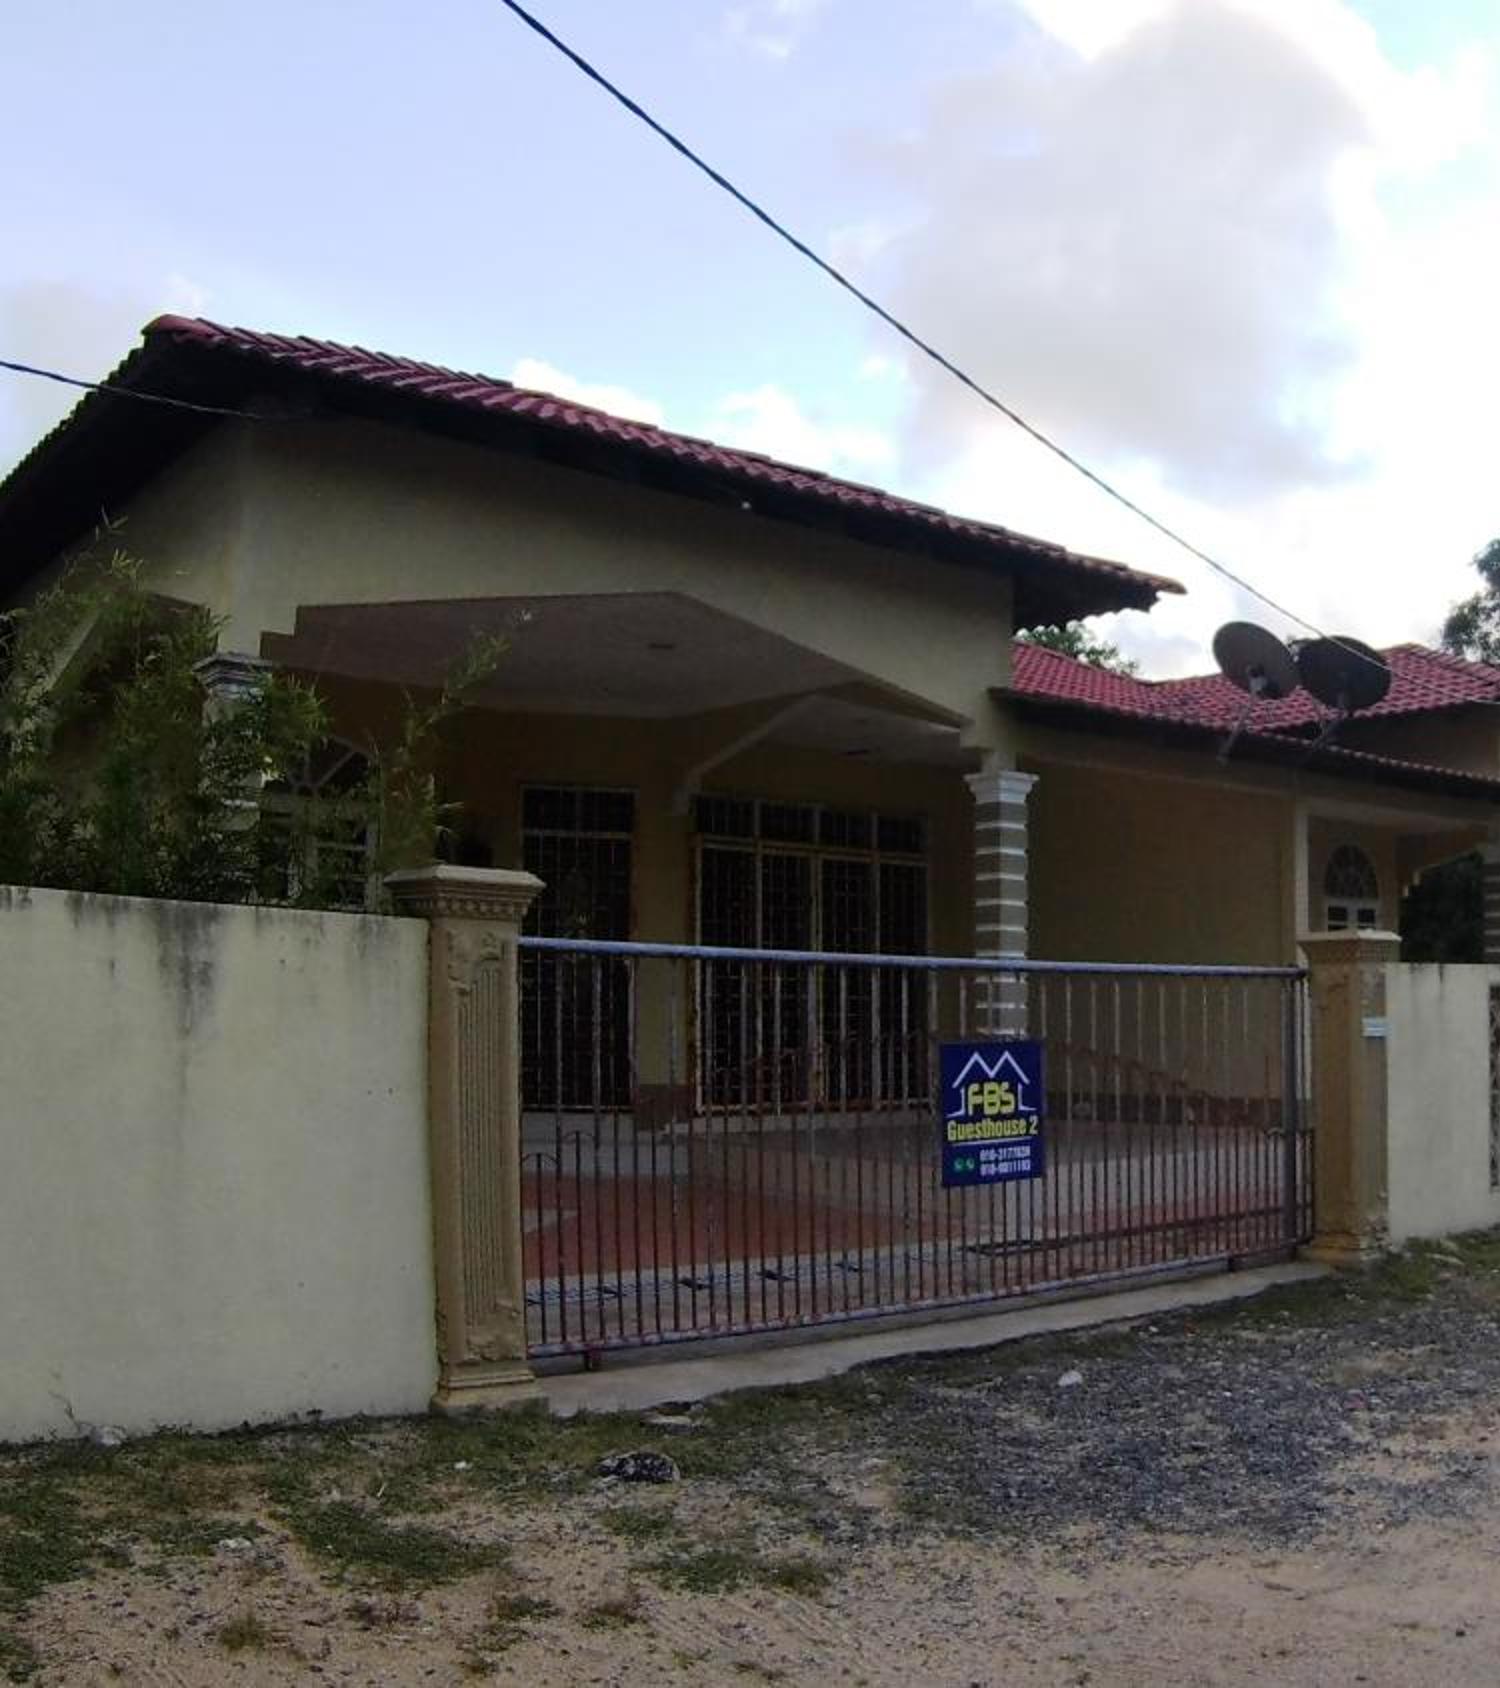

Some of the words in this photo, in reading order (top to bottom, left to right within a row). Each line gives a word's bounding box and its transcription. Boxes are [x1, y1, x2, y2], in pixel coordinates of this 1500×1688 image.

[967, 1081, 1015, 1116] FBS
[947, 1118, 1027, 1141] Guesthouse
[1029, 1115, 1039, 1135] 2
